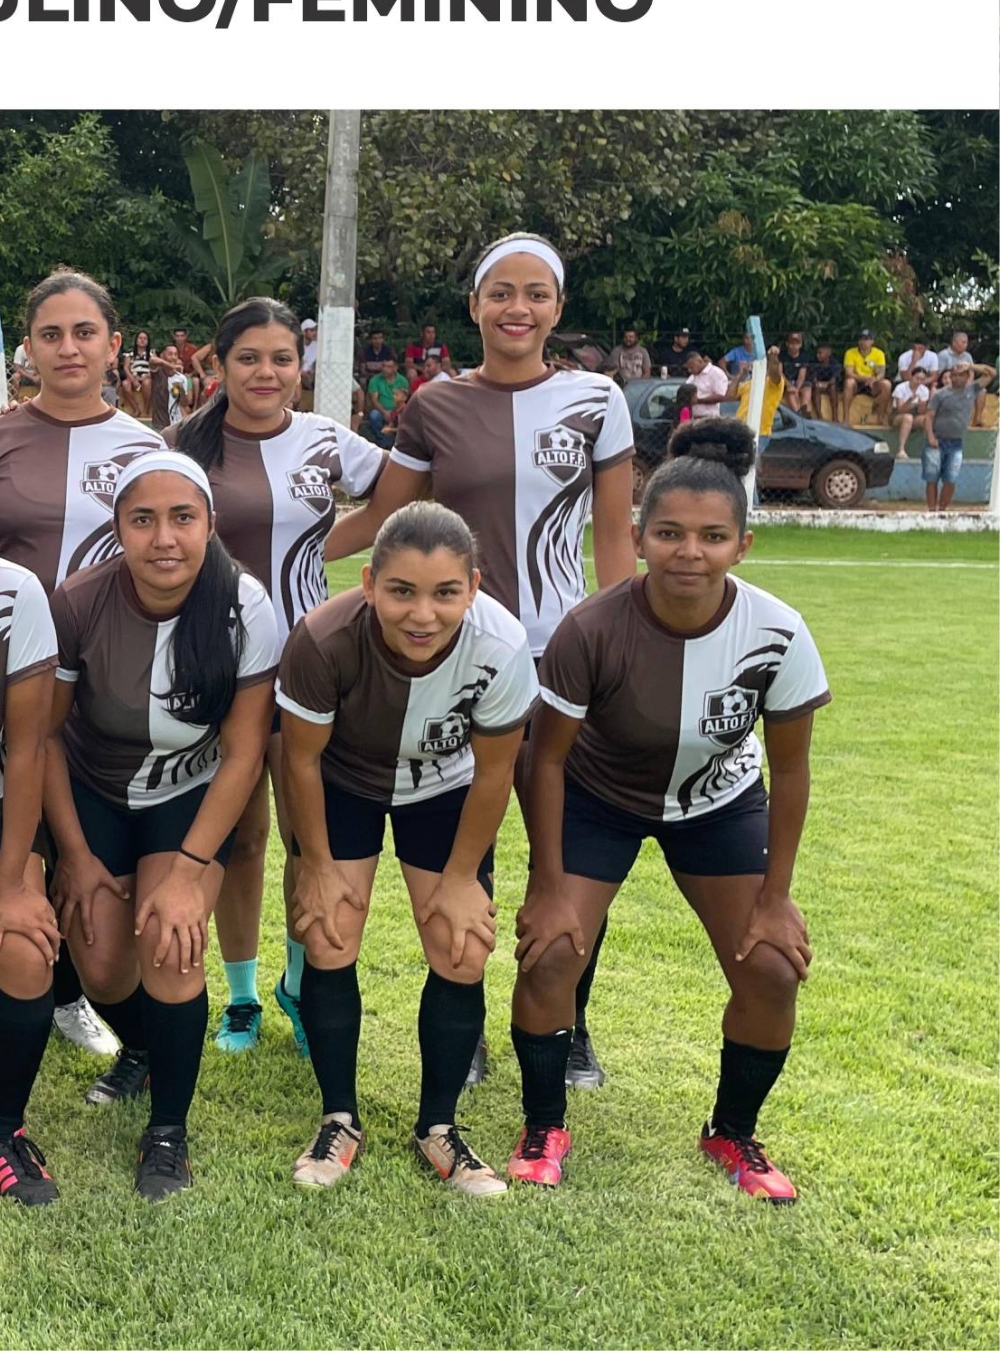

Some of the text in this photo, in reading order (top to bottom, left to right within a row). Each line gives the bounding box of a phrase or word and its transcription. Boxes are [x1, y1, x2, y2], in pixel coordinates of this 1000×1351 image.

[537, 450, 568, 465] ALTO
[85, 481, 114, 493] ALTO
[294, 484, 321, 498] ALTO
[705, 716, 739, 733] ALTO
[424, 736, 458, 751] ALTO
